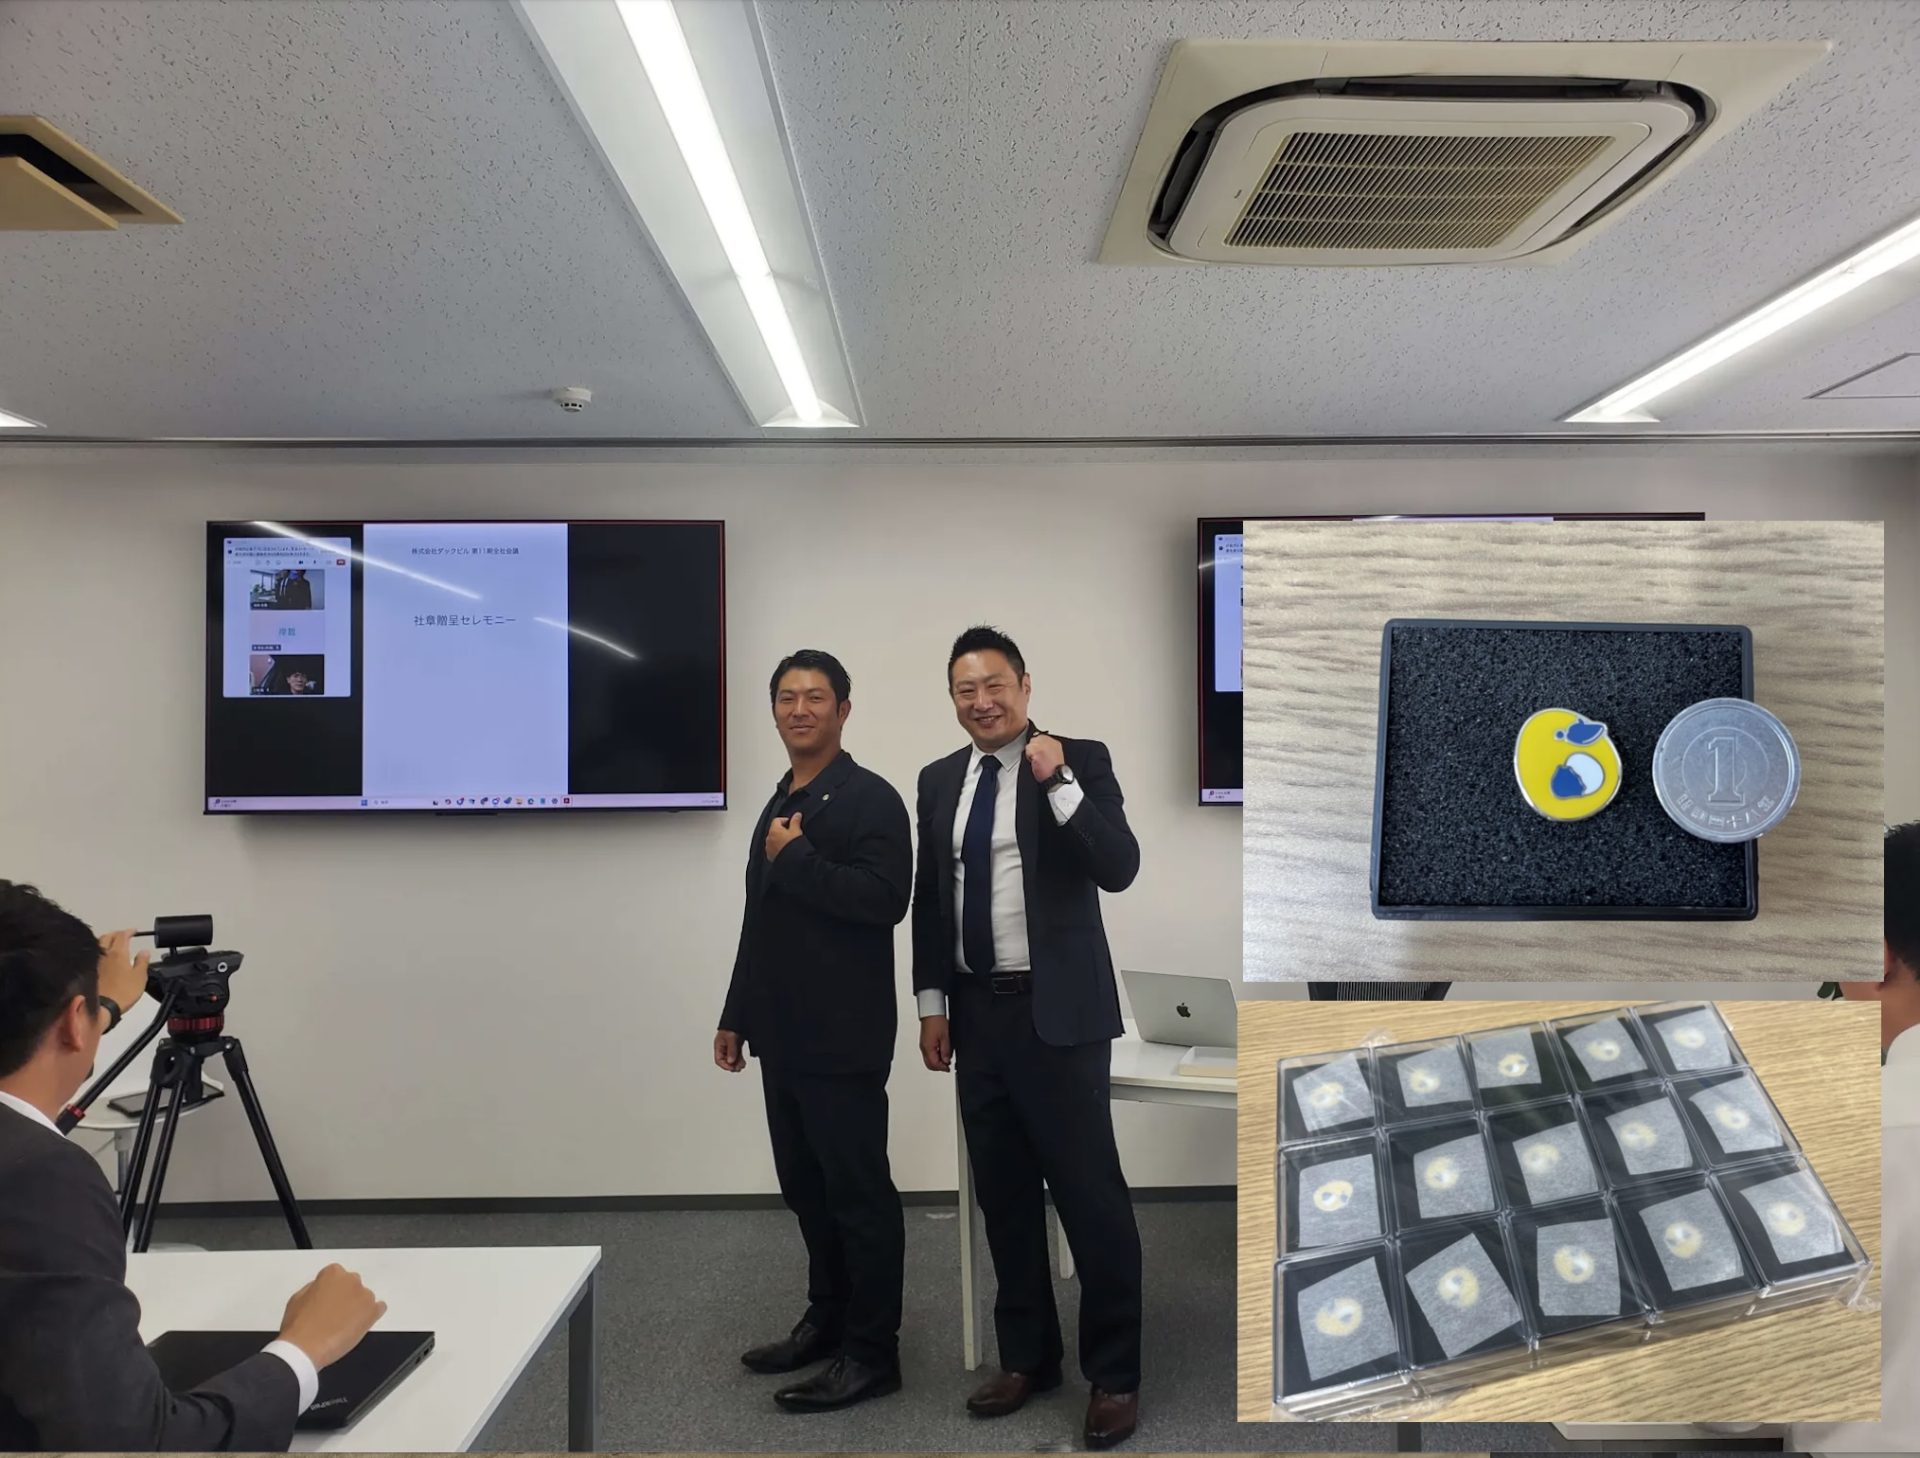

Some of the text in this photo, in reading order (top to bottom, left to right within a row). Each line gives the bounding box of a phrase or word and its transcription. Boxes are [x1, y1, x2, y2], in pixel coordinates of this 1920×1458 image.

[411, 547, 469, 555] 株式会社ダックビル
[413, 614, 517, 626] 社章贈呈セレモニー
[1706, 736, 1746, 806] 1
